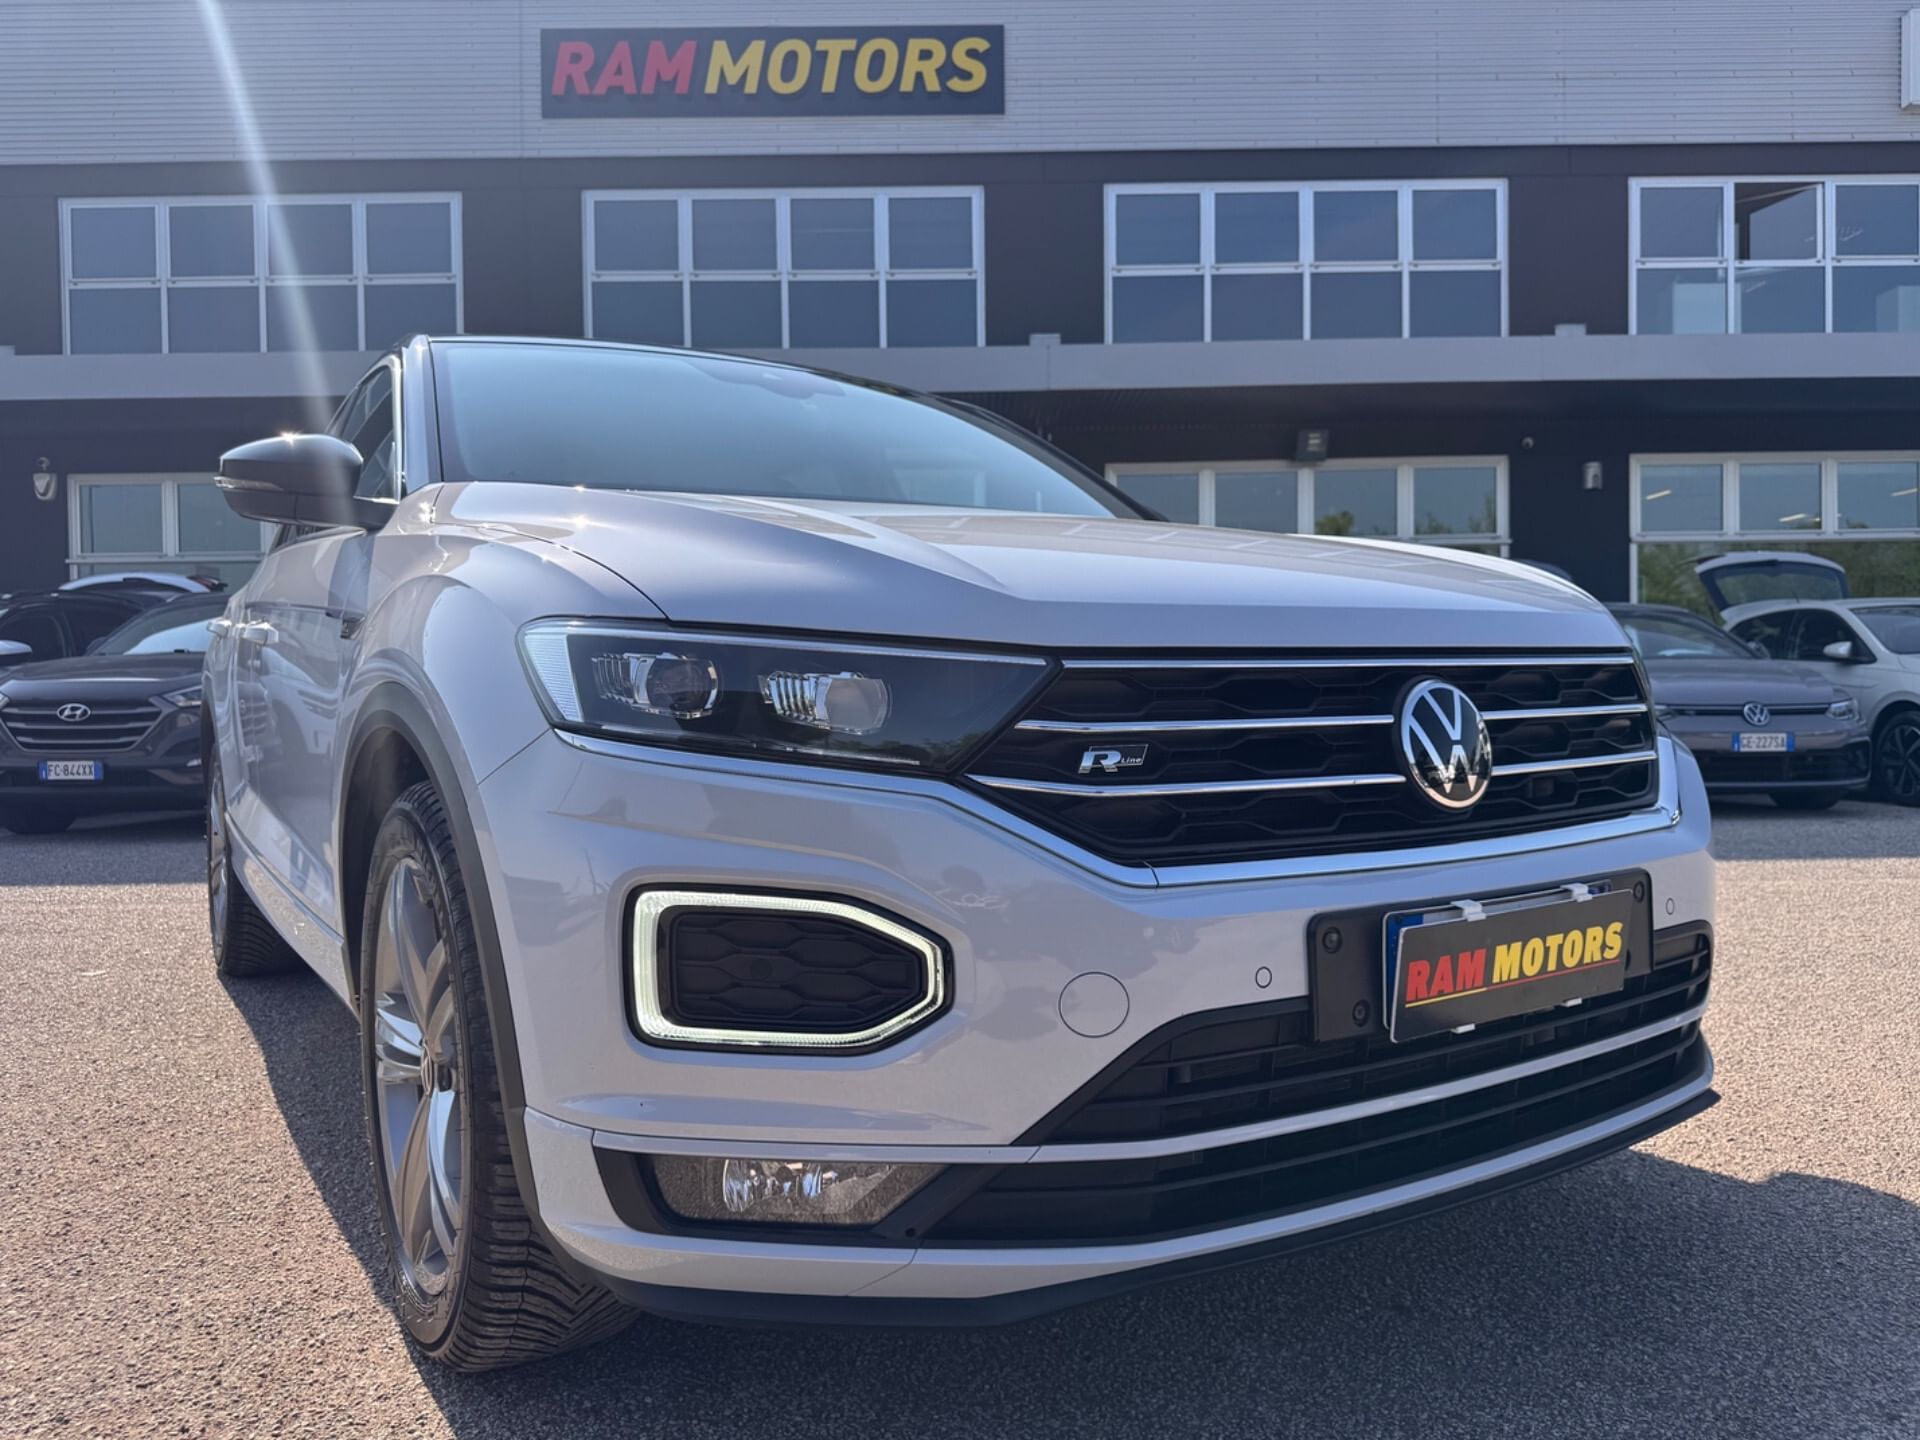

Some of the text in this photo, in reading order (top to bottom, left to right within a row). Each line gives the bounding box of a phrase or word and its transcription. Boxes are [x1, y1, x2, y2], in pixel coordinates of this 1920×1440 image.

[551, 37, 991, 95] RAM MOTORS
[1078, 750, 1122, 774] R
[1406, 921, 1623, 1002] RAM MOTORS
